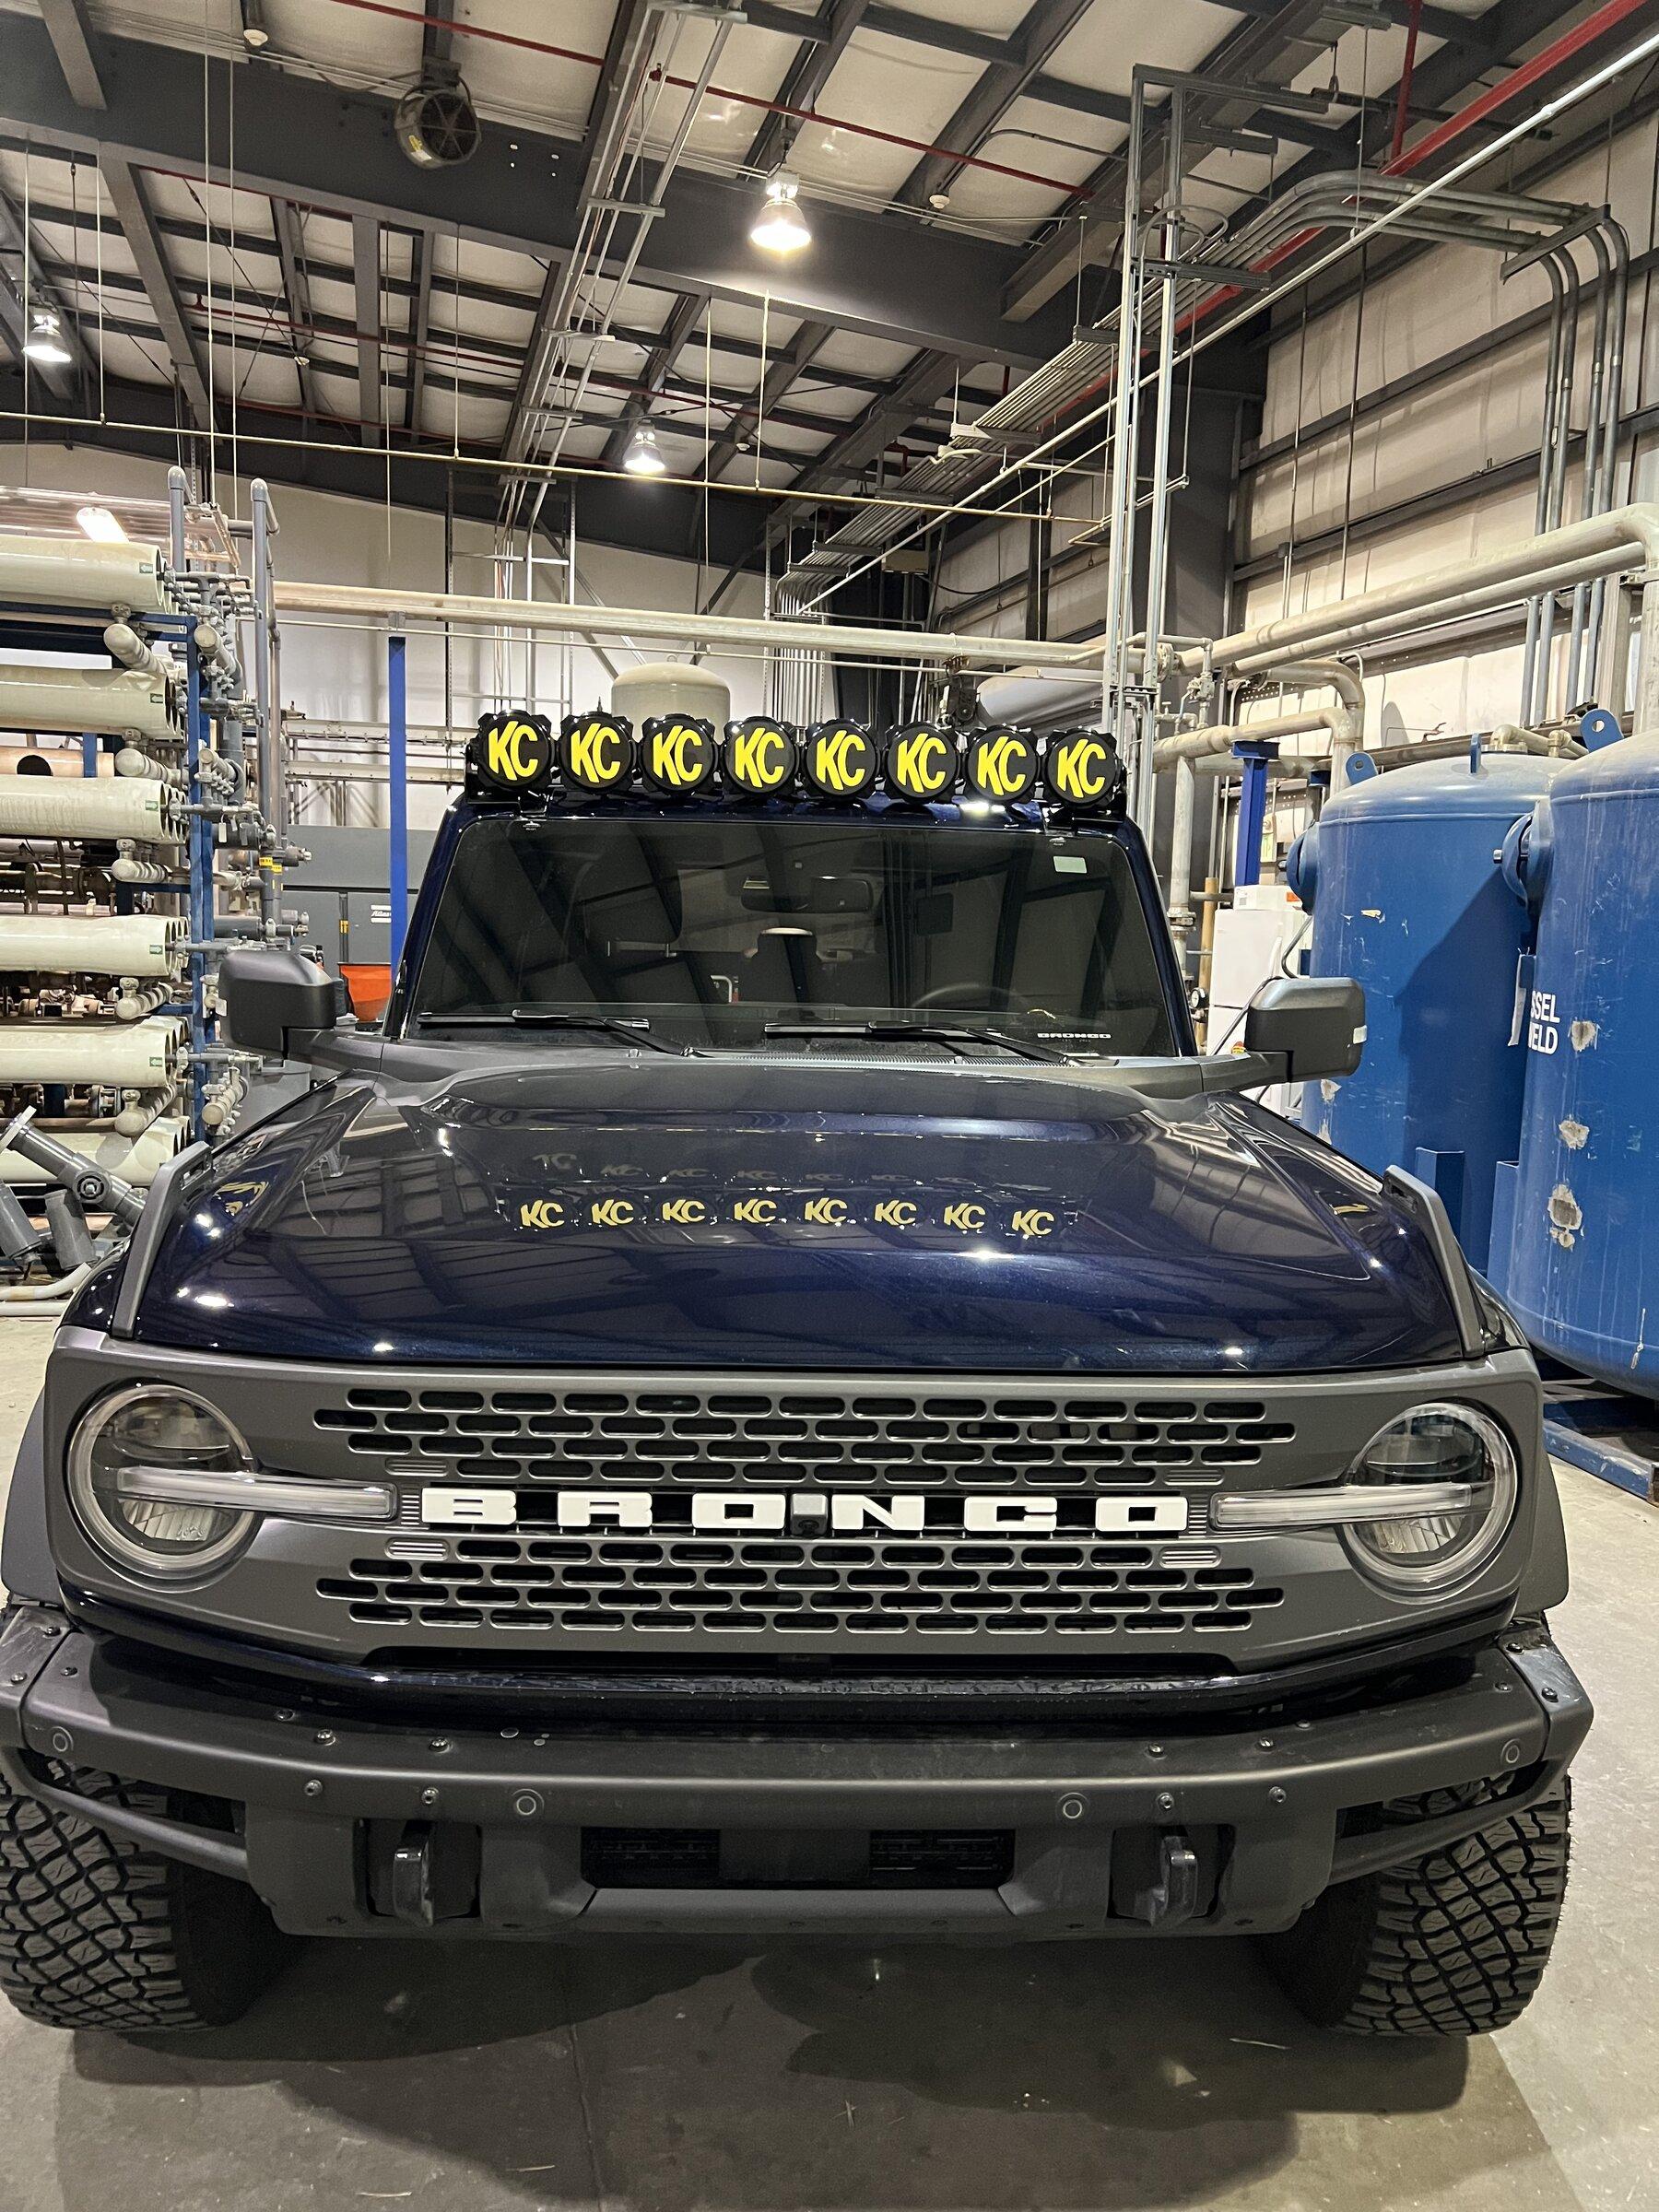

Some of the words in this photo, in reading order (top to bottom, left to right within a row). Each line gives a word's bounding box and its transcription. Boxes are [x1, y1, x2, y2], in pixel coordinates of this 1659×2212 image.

[488, 722, 536, 779] KC
[571, 724, 620, 782] KC
[653, 726, 702, 783] KC
[735, 728, 783, 787] KC
[816, 732, 865, 790] KC
[897, 735, 946, 792] KC
[977, 737, 1026, 794] KC
[1057, 740, 1105, 796] KC
[521, 1199, 565, 1229] KC
[591, 1198, 634, 1226] KC
[662, 1198, 706, 1224] KC
[734, 1198, 777, 1224] KC
[804, 1197, 849, 1224] KC
[875, 1199, 917, 1226] KC
[944, 1203, 986, 1230] KC
[1012, 1209, 1054, 1236] KC
[420, 1488, 1188, 1532] BRONCO
